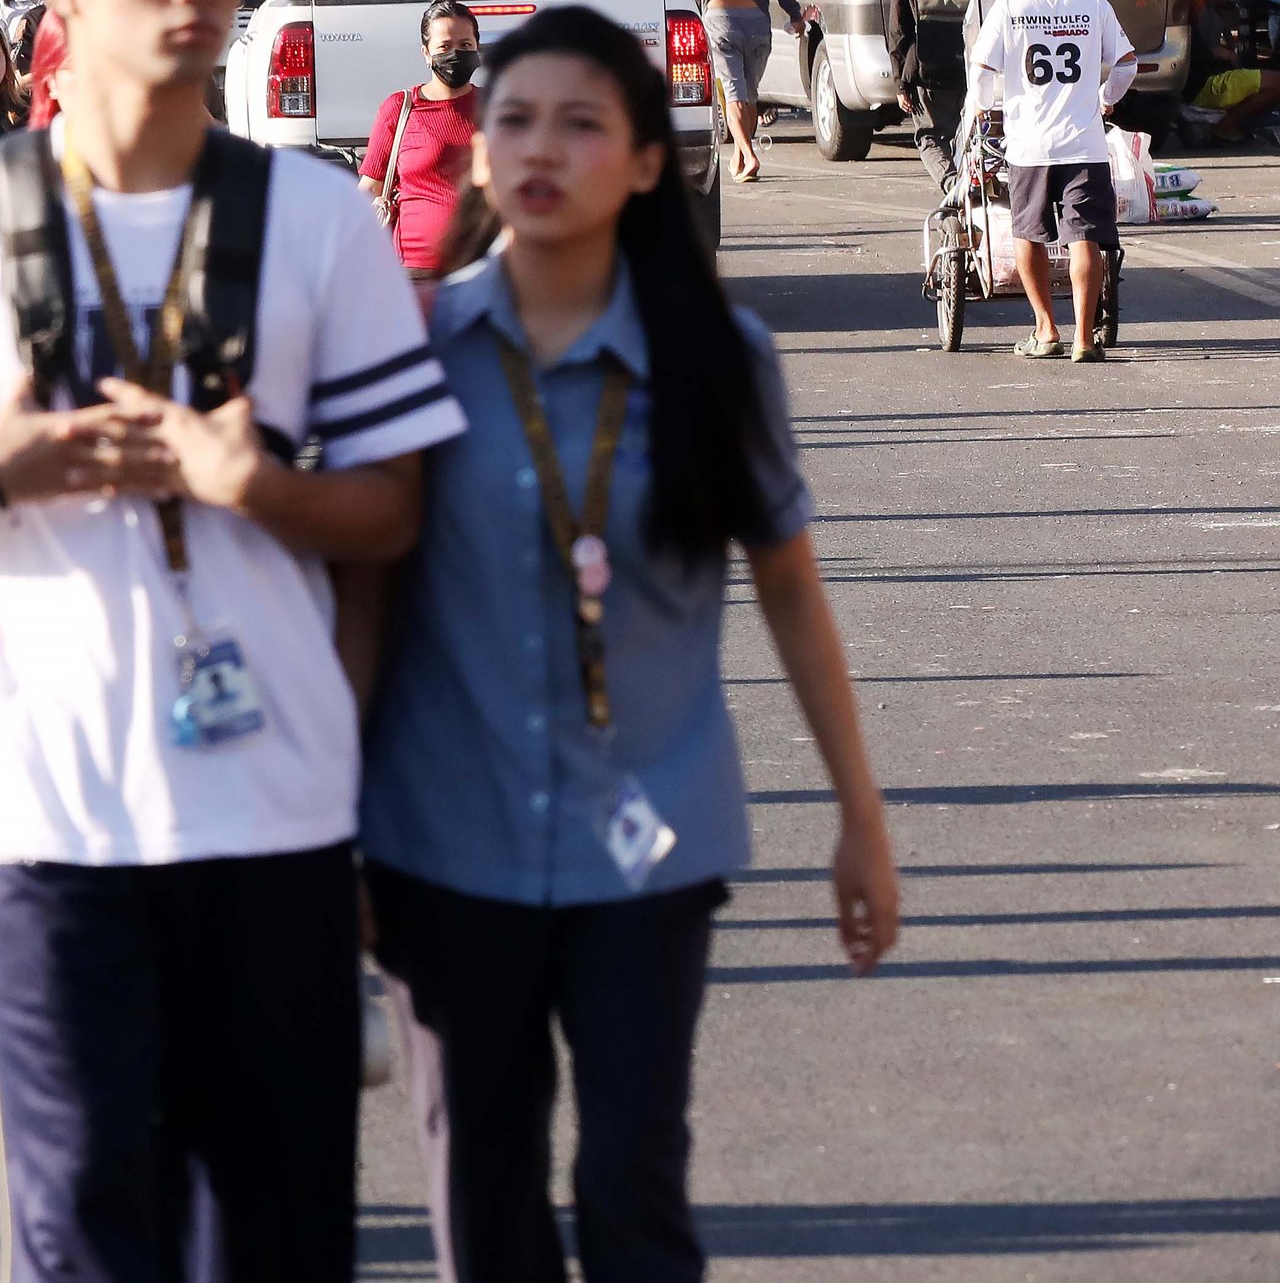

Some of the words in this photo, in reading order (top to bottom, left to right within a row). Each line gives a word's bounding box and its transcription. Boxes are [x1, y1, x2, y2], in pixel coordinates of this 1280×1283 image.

[1011, 15, 1051, 25] ERWIN
[1053, 14, 1090, 25] TULFO
[320, 33, 363, 42] TOYOTA
[1025, 43, 1081, 86] 63
